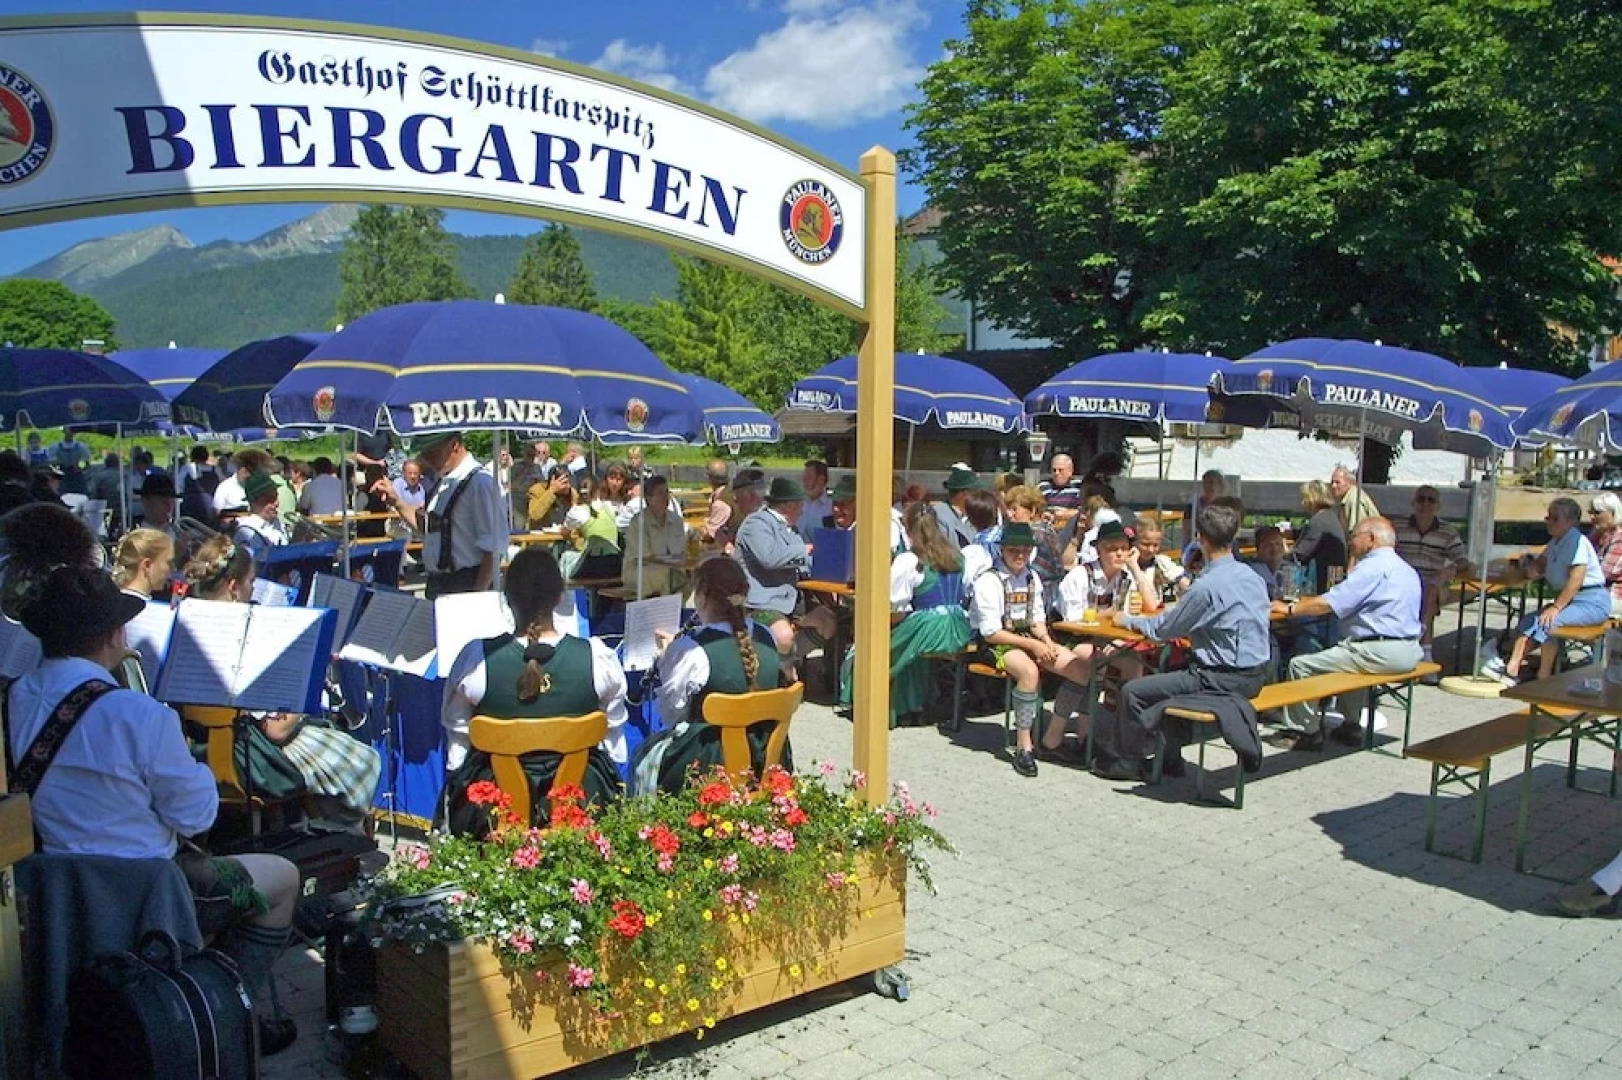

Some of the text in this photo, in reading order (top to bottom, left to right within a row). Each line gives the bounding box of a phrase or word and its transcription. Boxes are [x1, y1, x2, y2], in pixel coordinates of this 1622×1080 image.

[258, 49, 408, 101] Gasthof
[114, 103, 749, 237] BIERGARTEN
[785, 182, 841, 225] PAULANER
[409, 397, 562, 428] PAULANER
[1068, 396, 1151, 415] PAULANER
[1324, 384, 1420, 417] PAULANER
[721, 424, 771, 439] PAULANER
[946, 411, 1005, 428] PAULANER
